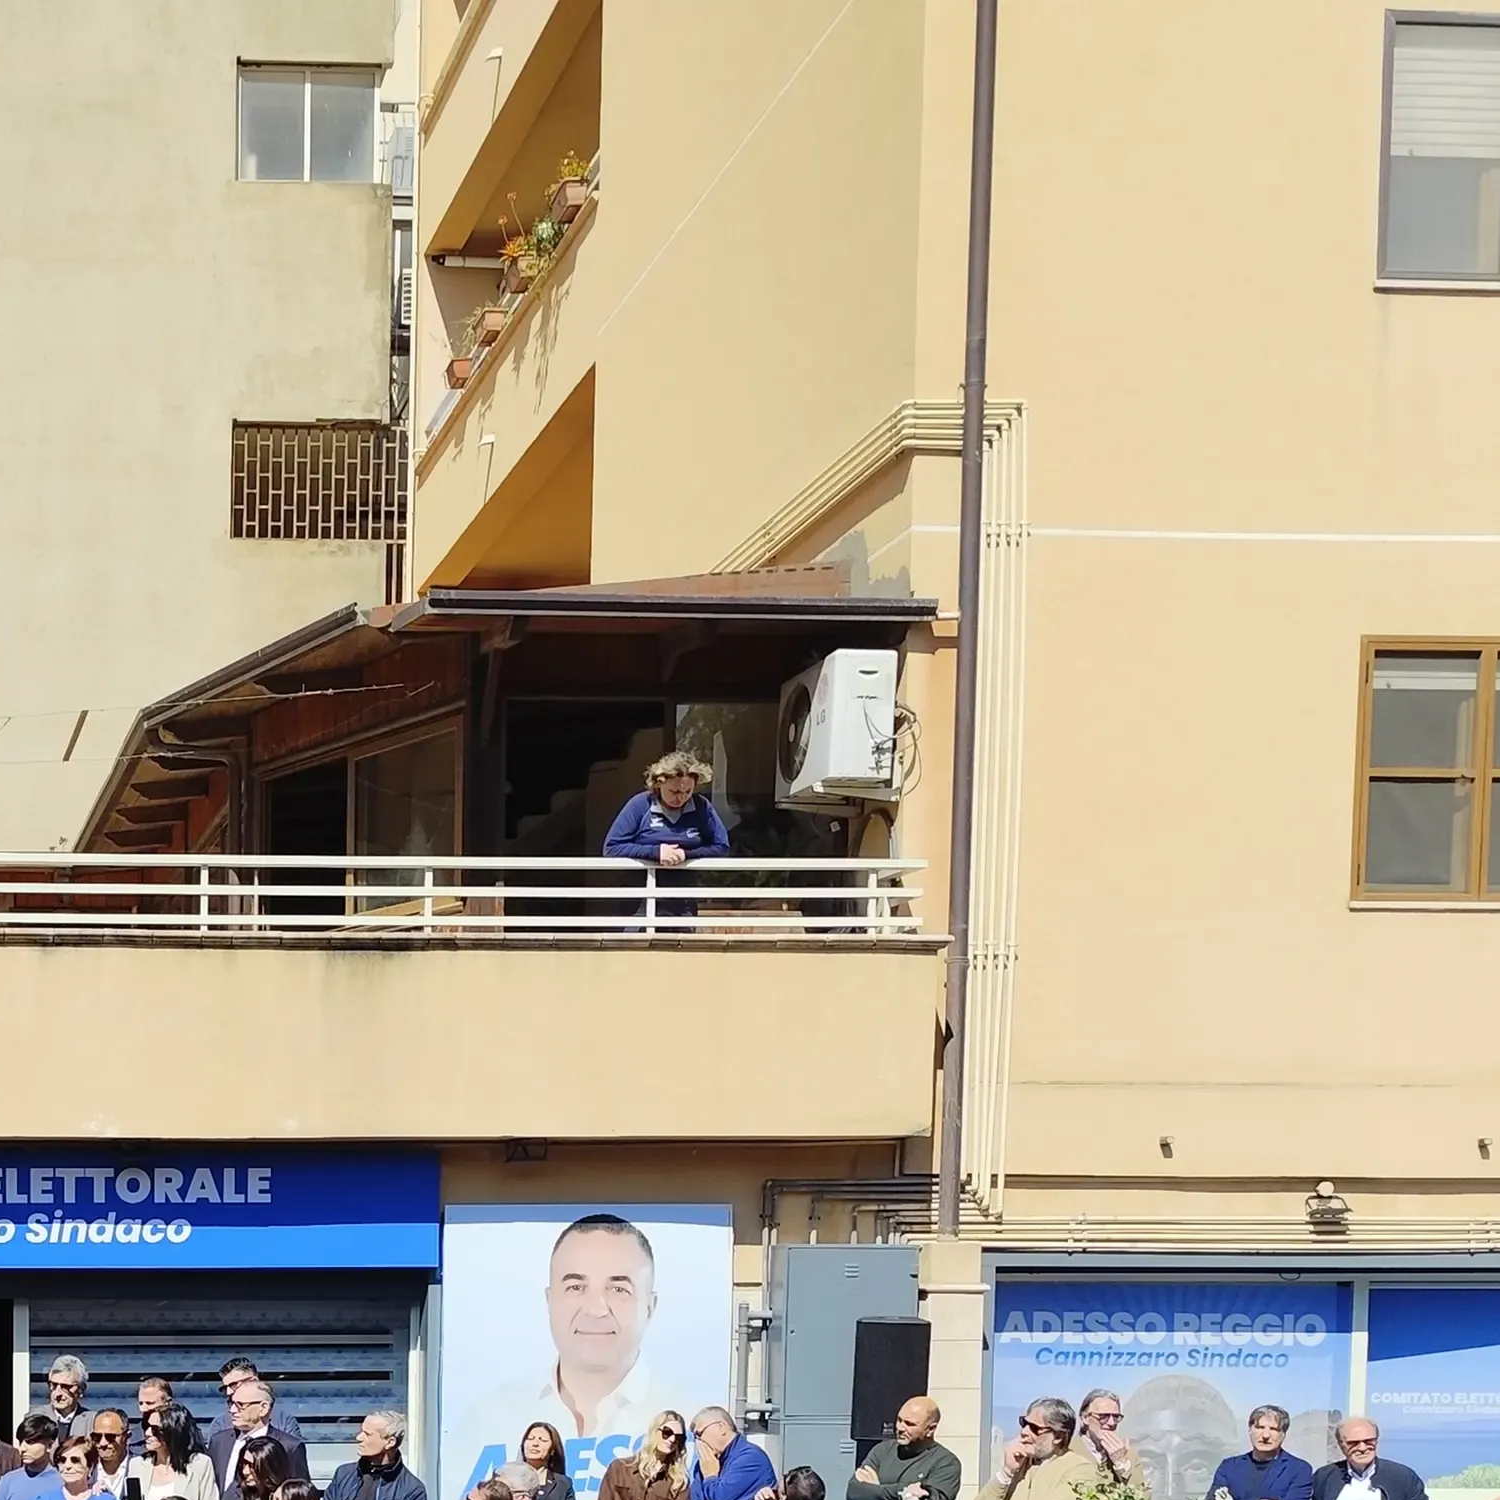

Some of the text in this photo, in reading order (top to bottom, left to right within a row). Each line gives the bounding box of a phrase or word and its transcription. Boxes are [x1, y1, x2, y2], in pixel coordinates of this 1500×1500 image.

[816, 709, 826, 726] LG
[25, 1208, 192, 1244] Sindaco
[1000, 1310, 1327, 1347] ADESSO REGGIO
[1035, 1345, 1289, 1369] Cannizzaro Sindaco
[1371, 1392, 1452, 1405] COMITATO
